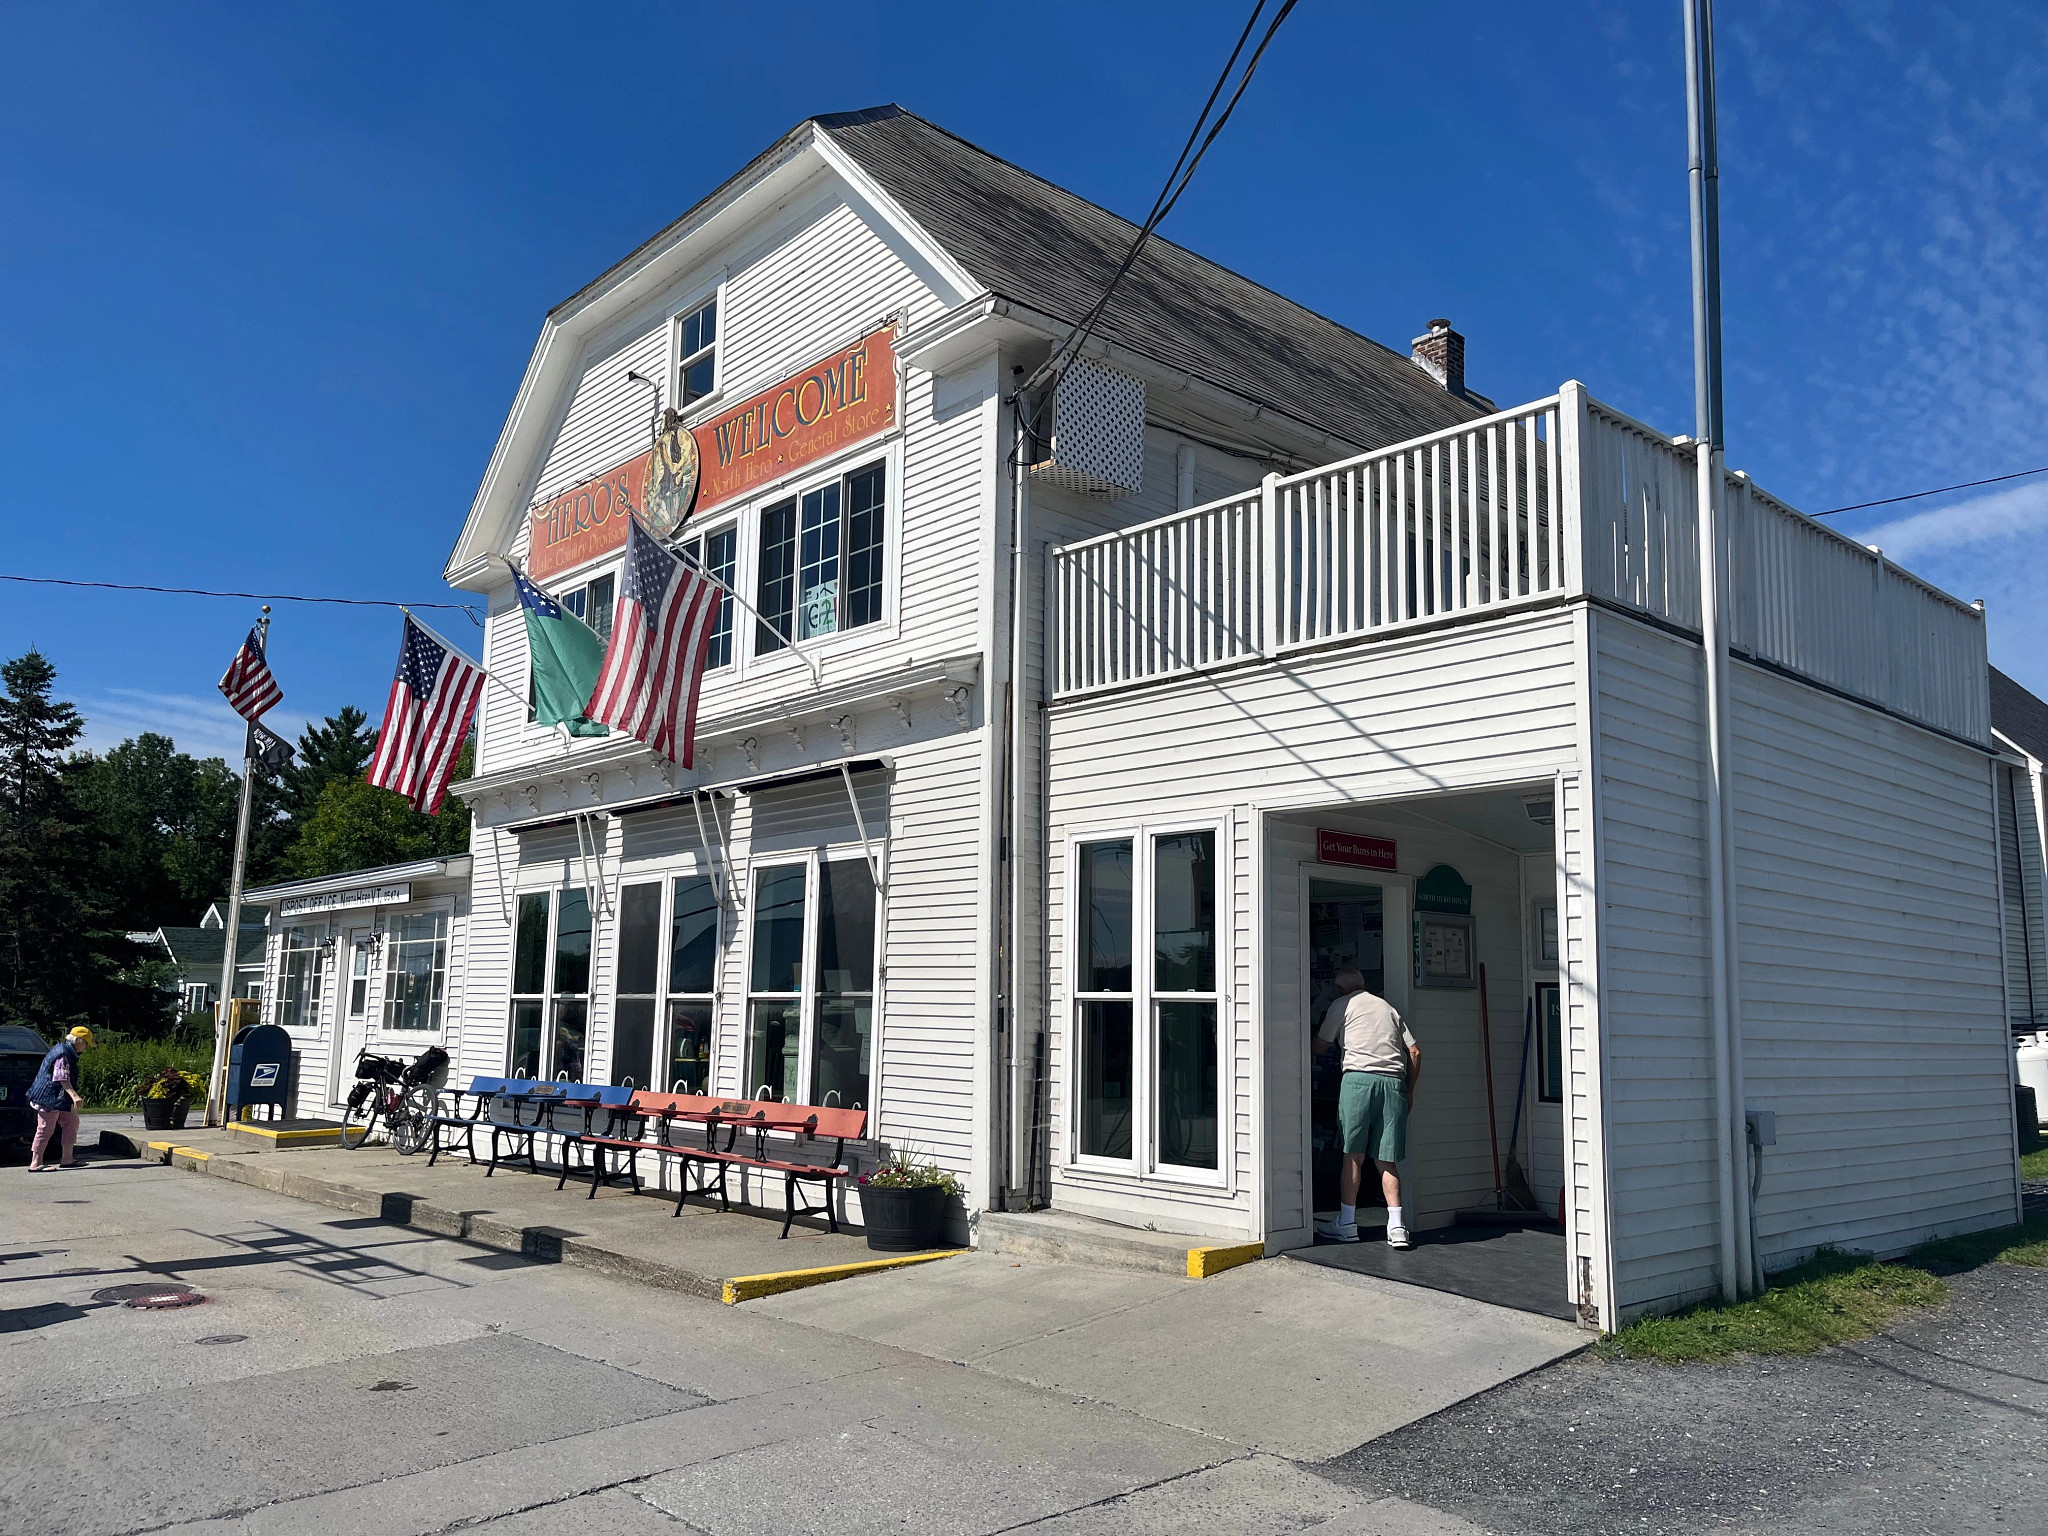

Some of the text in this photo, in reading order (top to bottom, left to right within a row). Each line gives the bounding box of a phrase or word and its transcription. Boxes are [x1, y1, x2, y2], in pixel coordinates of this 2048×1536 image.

[546, 471, 629, 549] HERO'S
[713, 346, 869, 469] WELCOME
[712, 408, 880, 498] North Hero General Store
[536, 555, 553, 574] Lake
[1322, 840, 1395, 860] Get Your Buns in Here
[310, 894, 337, 912] OFFICE
[1412, 920, 1420, 979] MENU
